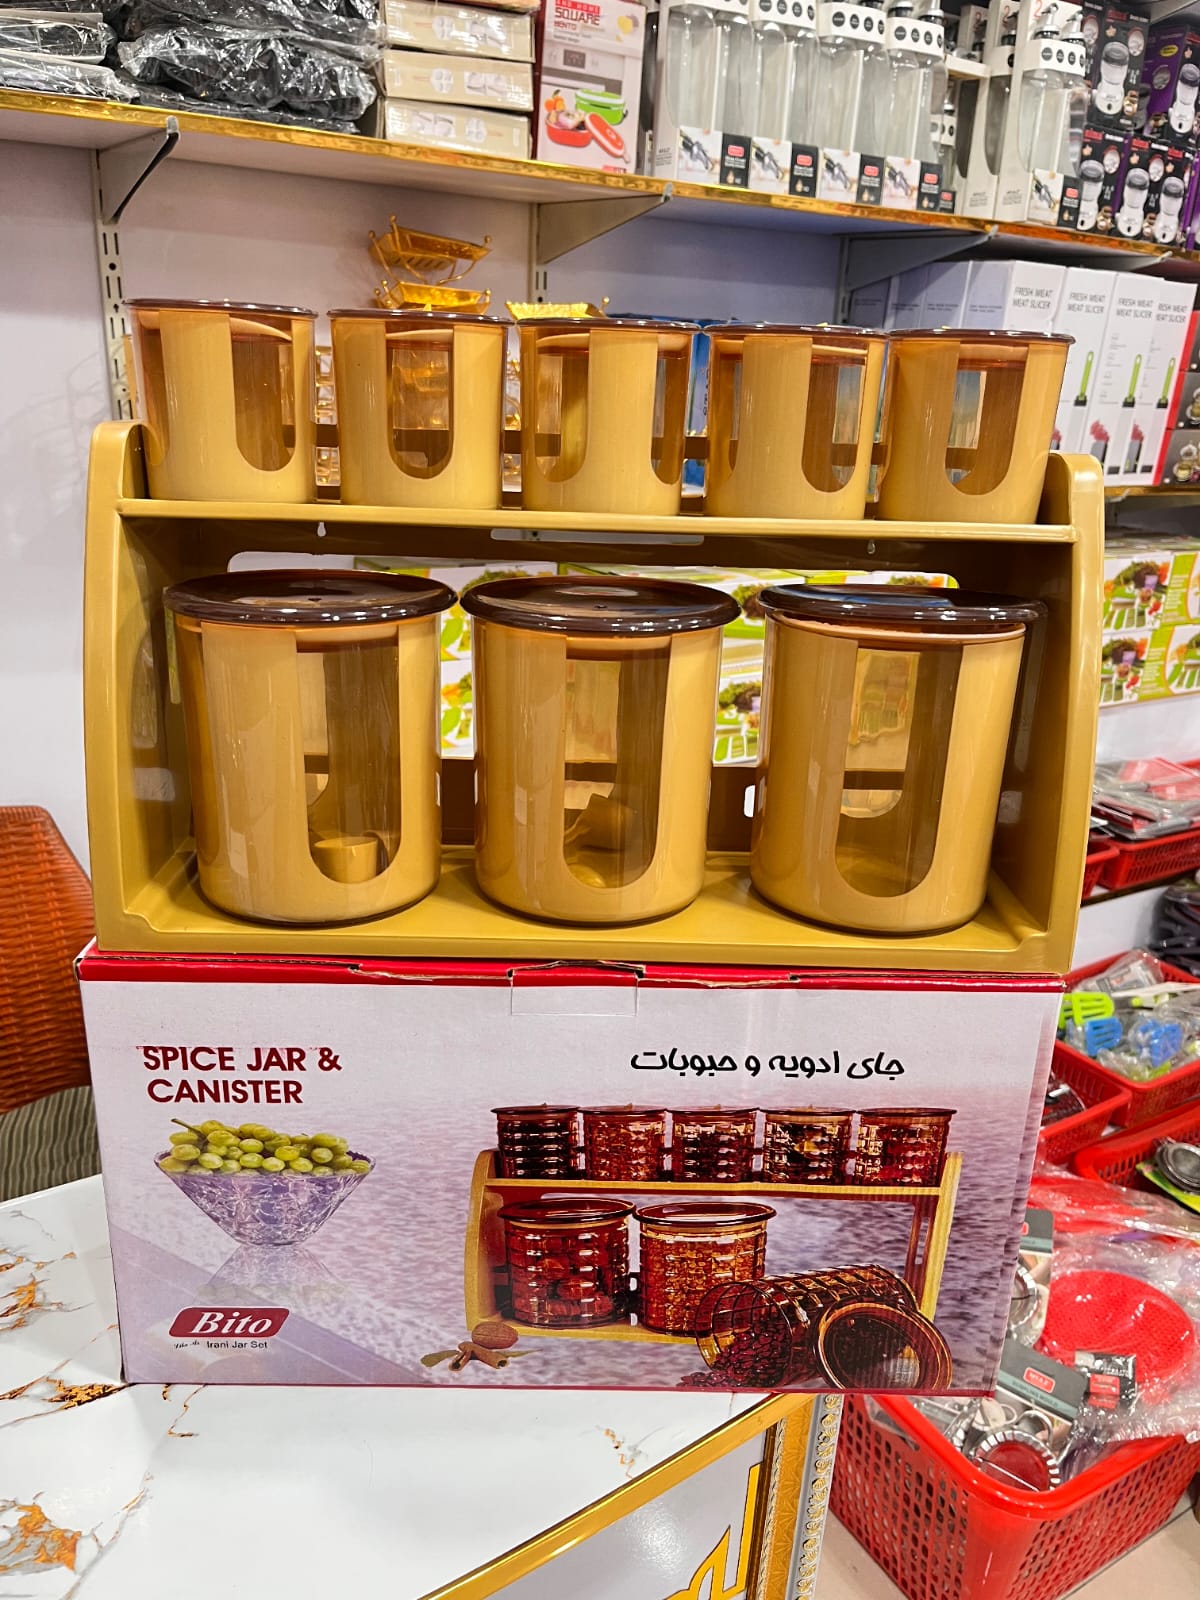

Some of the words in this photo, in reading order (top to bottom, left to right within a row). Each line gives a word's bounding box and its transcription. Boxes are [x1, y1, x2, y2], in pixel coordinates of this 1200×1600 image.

[555, 7, 600, 26] SQUARE
[1015, 287, 1033, 297] FRESH
[1035, 288, 1053, 299] MEAT
[1070, 292, 1088, 303] FRESH
[1089, 294, 1106, 305] MEAT
[1012, 298, 1029, 308] MEAT
[1030, 299, 1051, 310] SLICER
[1067, 303, 1084, 313] MEAT
[1085, 304, 1104, 315] SLICER
[1118, 298, 1136, 308] FRESH
[1137, 299, 1154, 309] MEAT
[1116, 308, 1132, 318] MEAT
[1133, 309, 1152, 320] SLICER
[143, 1045, 236, 1072] SPICE
[246, 1046, 307, 1073] JAR
[317, 1046, 343, 1073] &
[630, 1047, 738, 1077] حبوبات
[744, 1054, 762, 1077] و
[768, 1049, 841, 1079] ادویه
[846, 1051, 906, 1081] جای
[147, 1078, 304, 1105] CANISTER
[188, 1311, 272, 1334] Bito
[206, 1340, 229, 1349] Irani
[231, 1340, 247, 1349] Jar
[250, 1340, 268, 1349] Set
